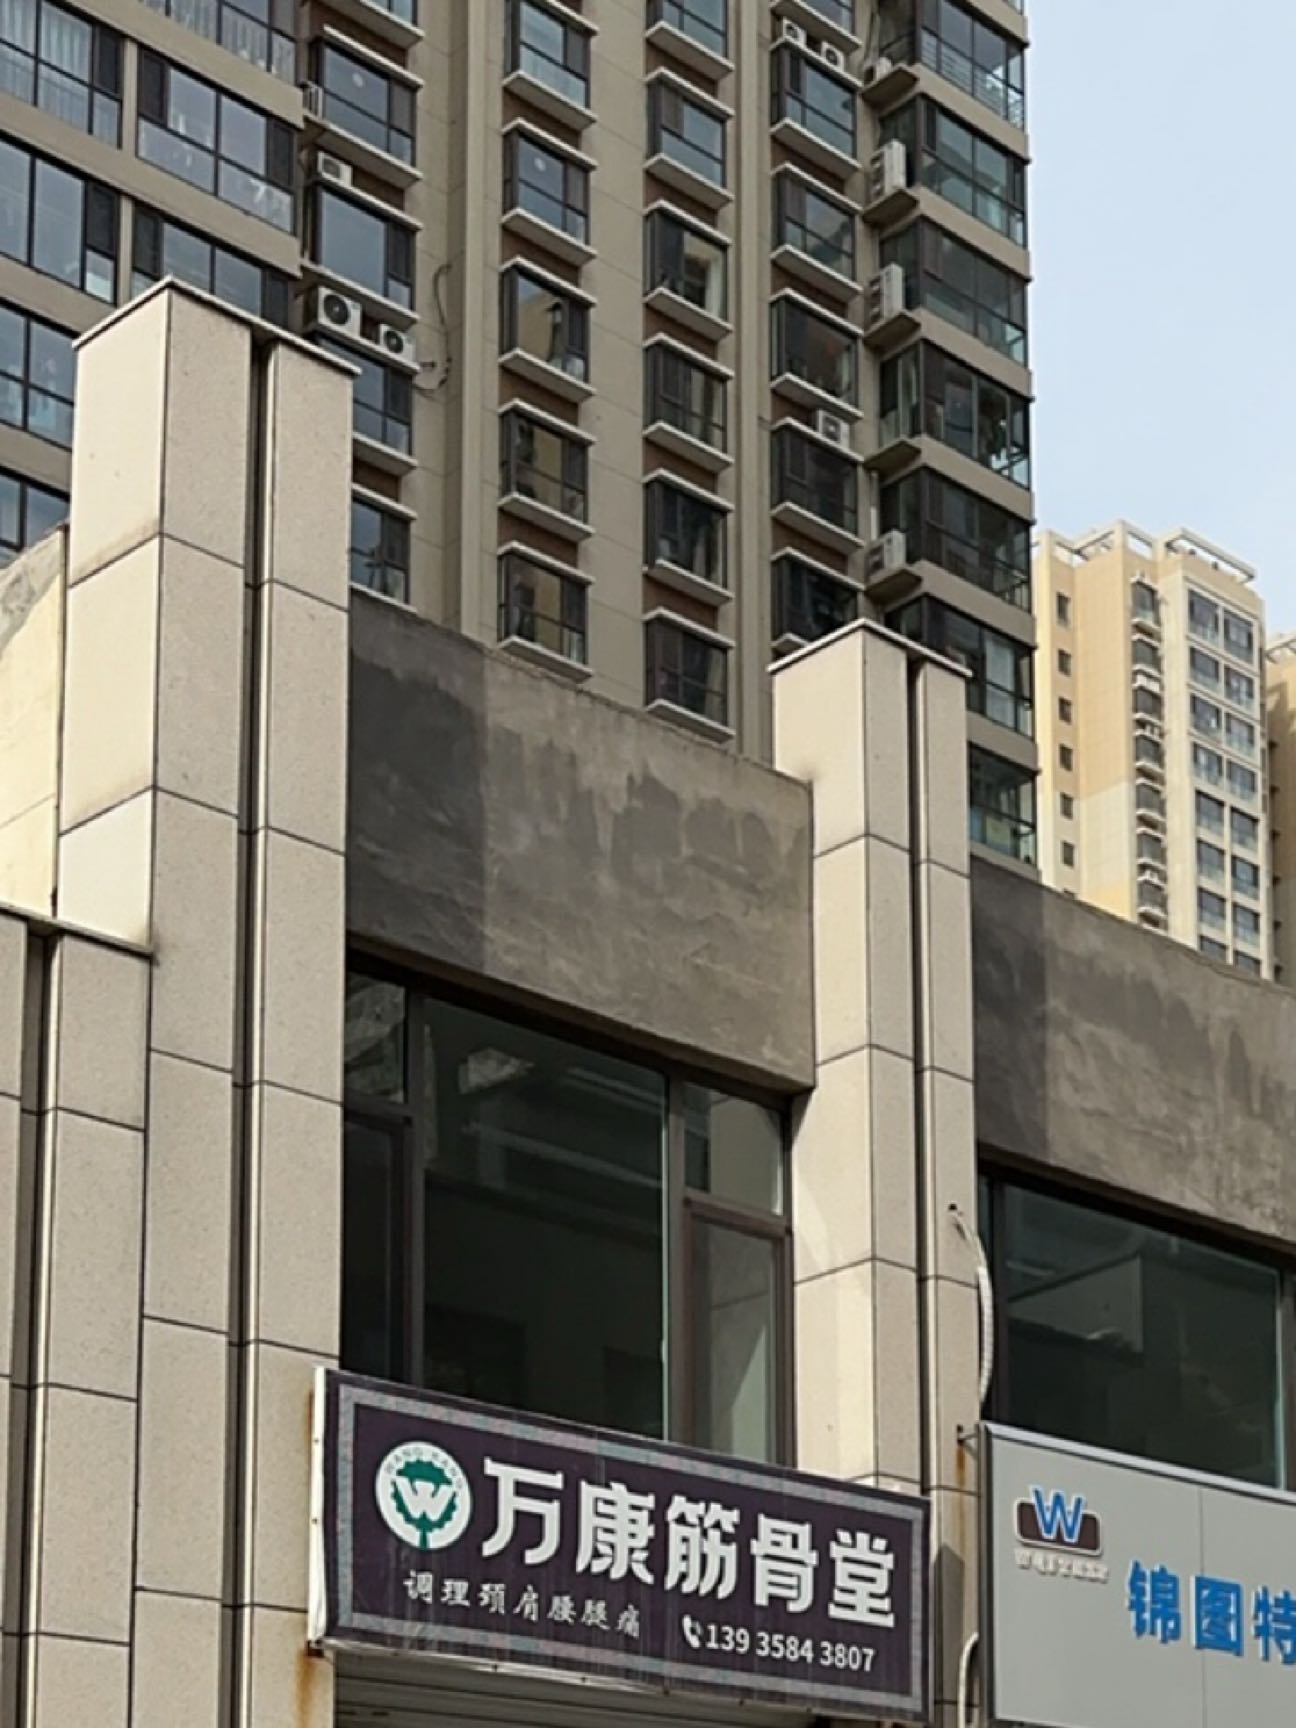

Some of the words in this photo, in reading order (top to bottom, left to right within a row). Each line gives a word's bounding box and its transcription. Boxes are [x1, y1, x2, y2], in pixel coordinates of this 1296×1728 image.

[481, 1457, 895, 1628] 万康筋骨堂
[1031, 1485, 1085, 1543] W
[404, 1569, 640, 1639] 调理颈肩腰腿痛
[705, 1623, 750, 1654] 139
[754, 1630, 814, 1663] 3584
[819, 1638, 876, 1674] 3807
